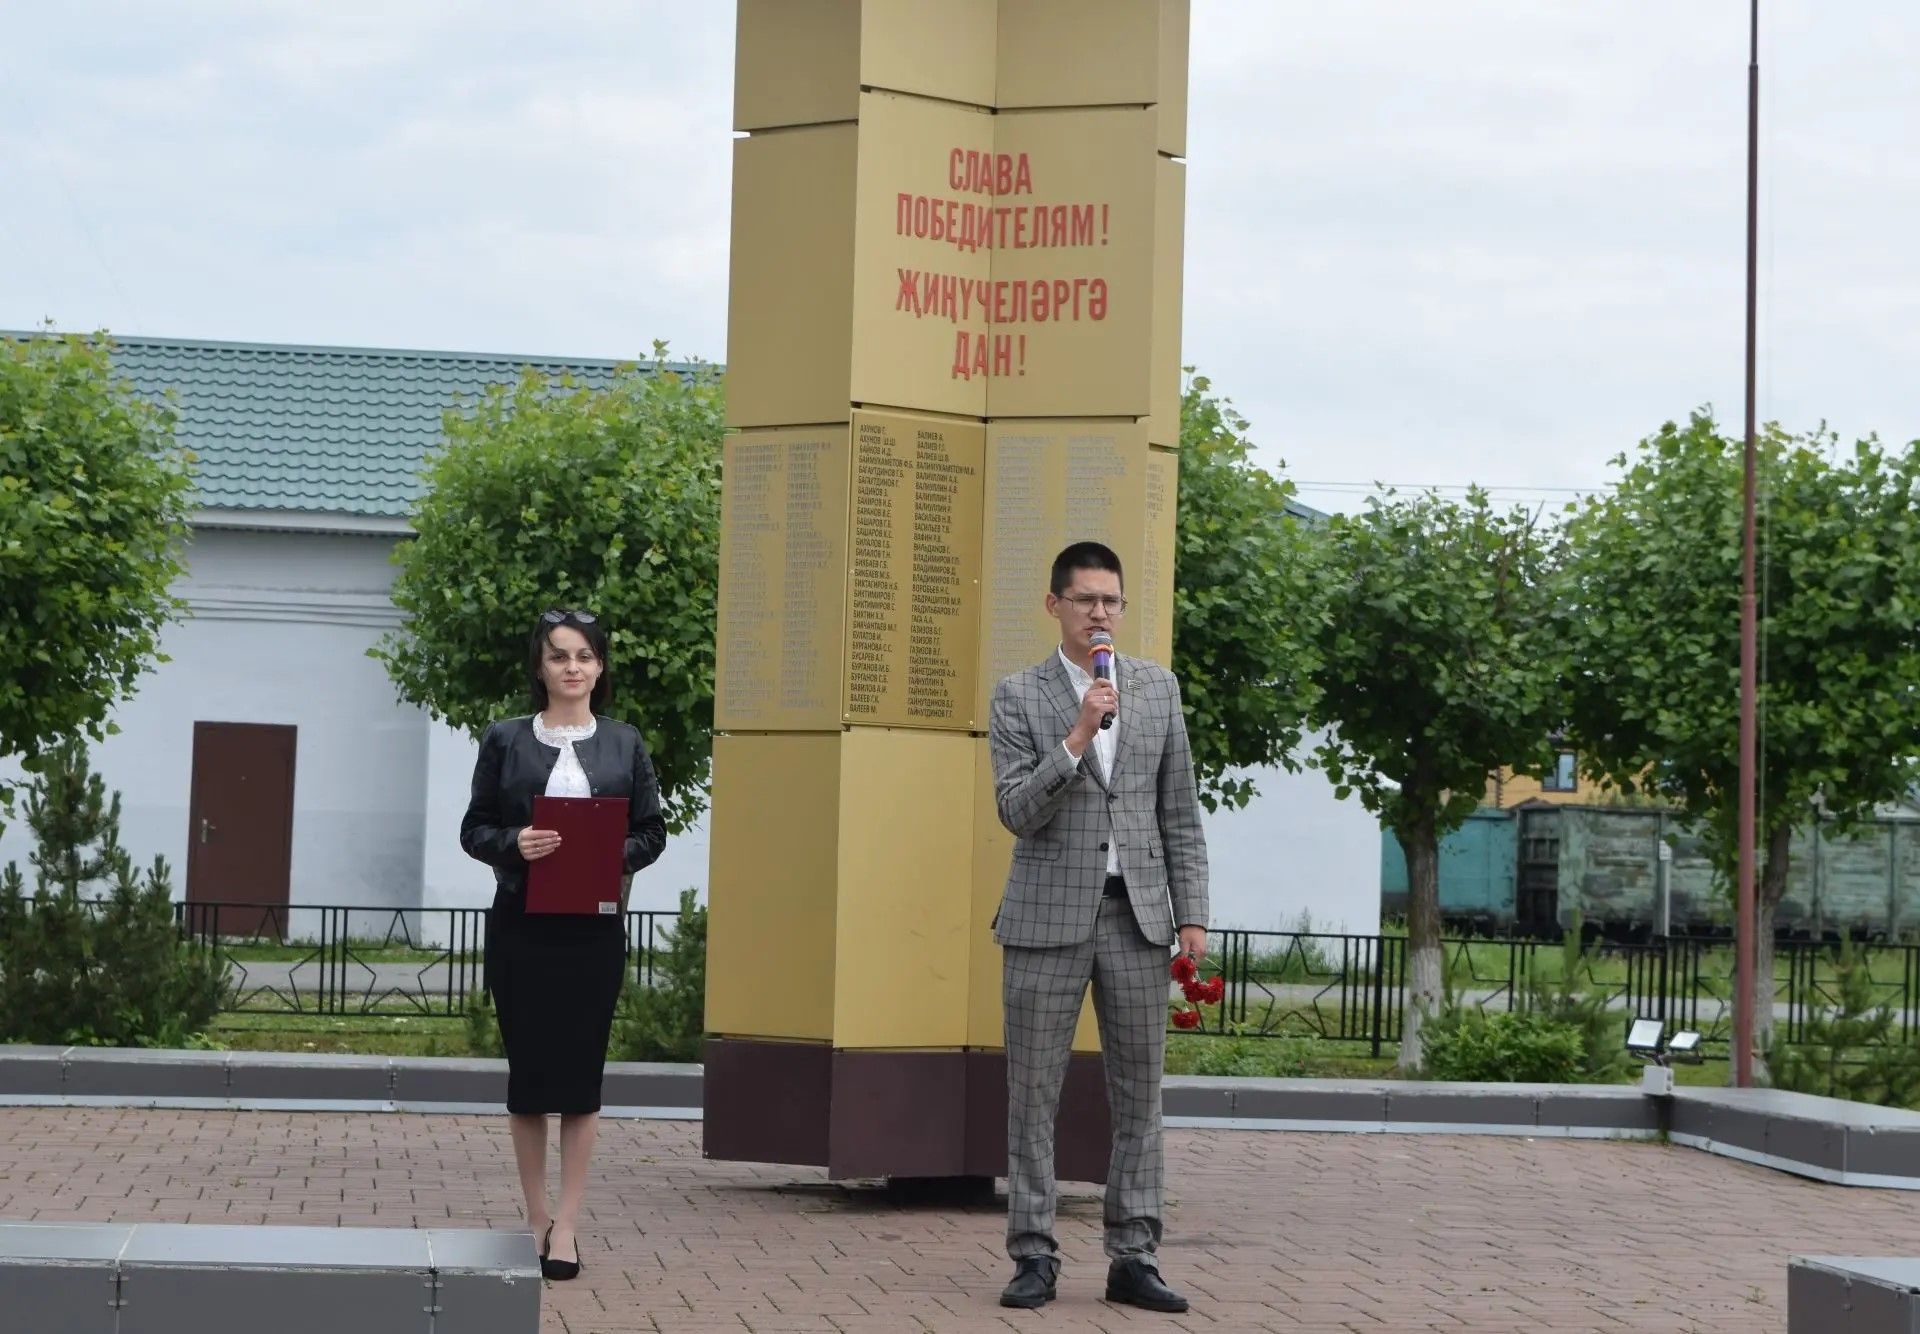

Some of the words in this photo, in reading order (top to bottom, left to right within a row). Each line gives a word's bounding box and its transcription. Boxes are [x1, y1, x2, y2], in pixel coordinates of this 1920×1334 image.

[950, 148, 1032, 196] СЛАВА
[897, 193, 1108, 253] ПОБЕДИТЕЛЯМ!
[896, 268, 1107, 323] ҖИҢҮЧЕЛӘРГӘ
[952, 331, 1025, 380] ДАН!
